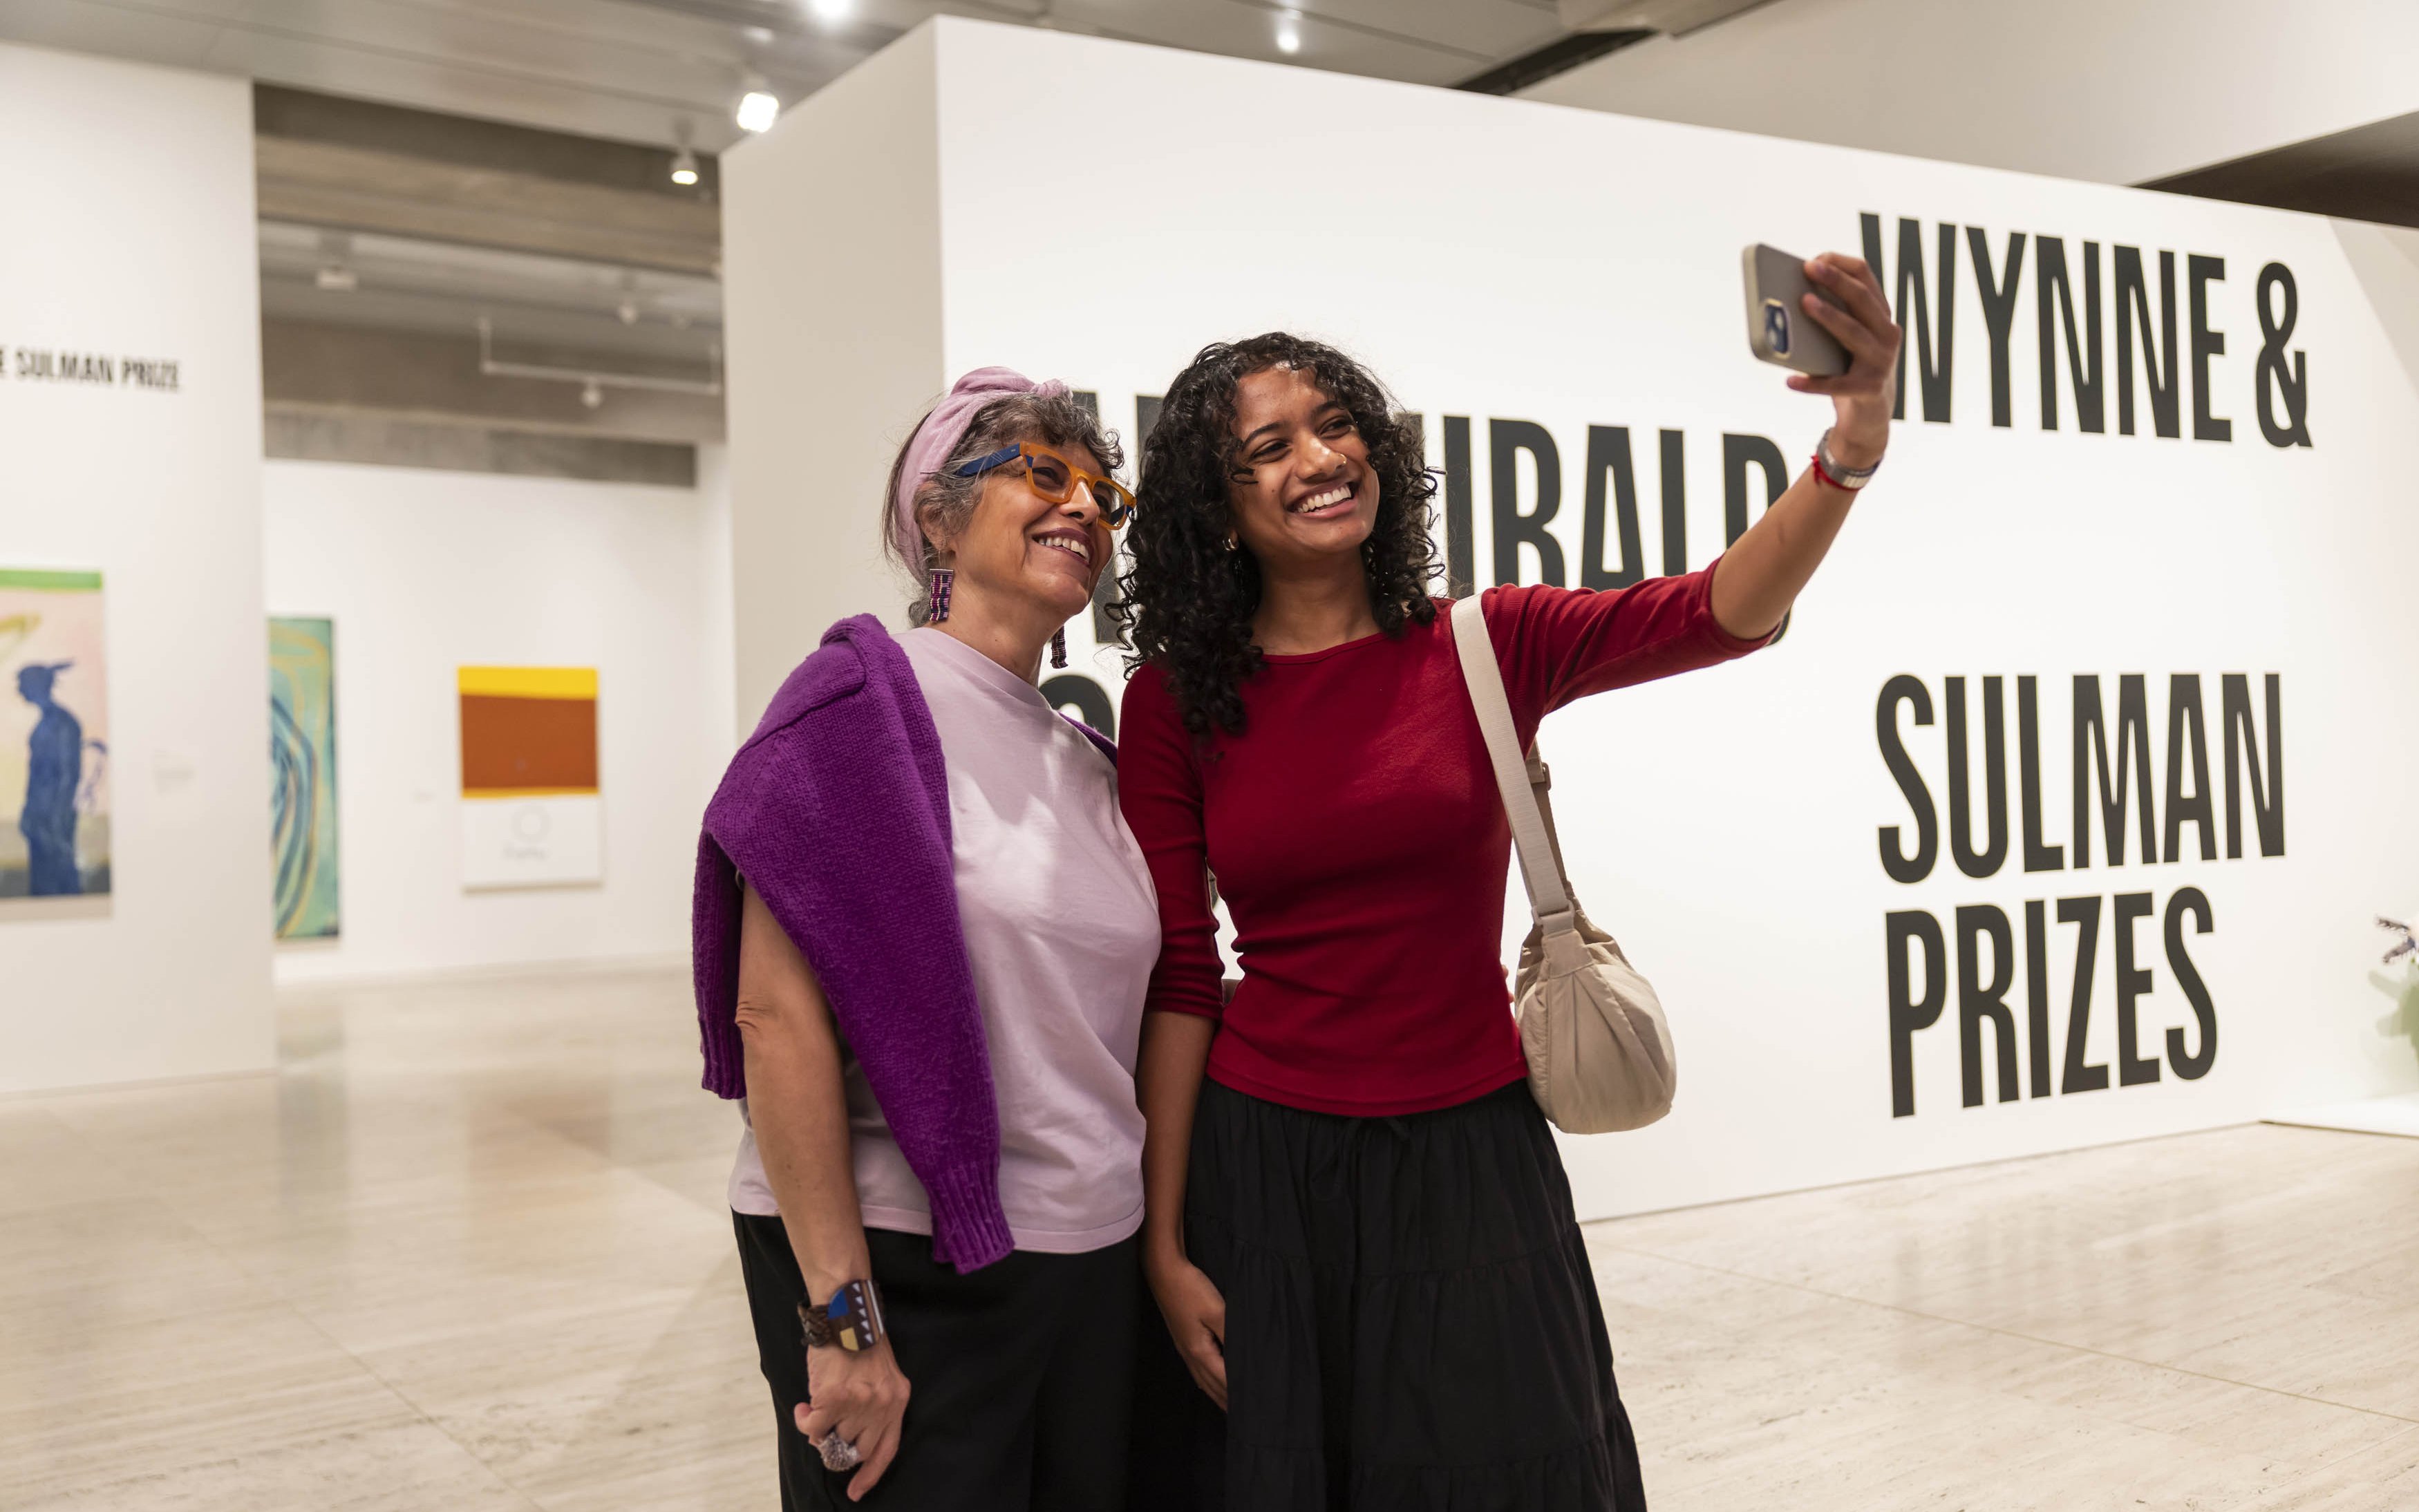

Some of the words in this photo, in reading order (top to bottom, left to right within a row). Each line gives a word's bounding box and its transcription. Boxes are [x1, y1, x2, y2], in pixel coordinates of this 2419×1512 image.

[15, 348, 115, 384] SULMAN
[120, 357, 180, 391] PRIZE
[1858, 211, 2233, 443] WYNNE
[2255, 261, 2313, 448] &
[1875, 672, 2286, 885] SULMAN
[1885, 886, 2218, 1119] PRIZES
